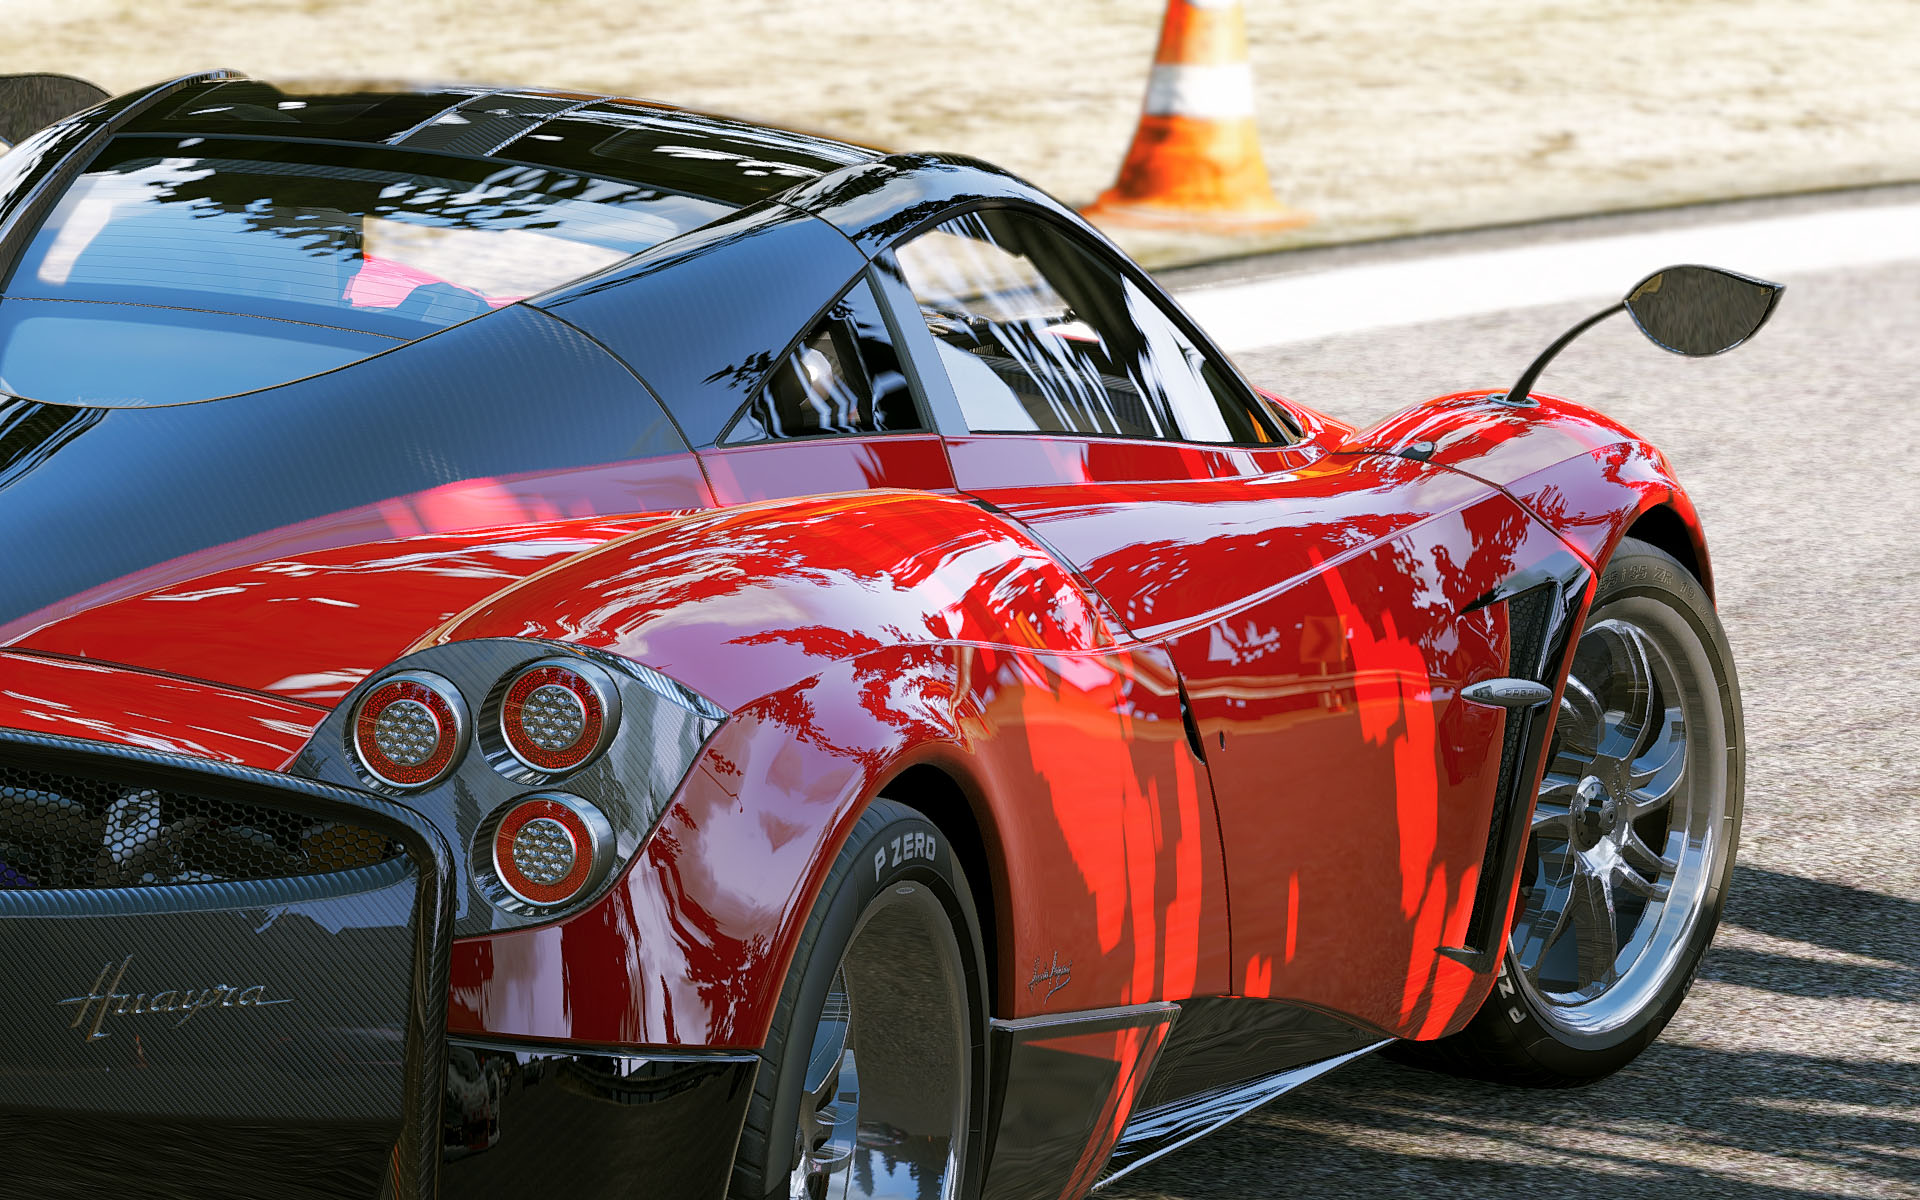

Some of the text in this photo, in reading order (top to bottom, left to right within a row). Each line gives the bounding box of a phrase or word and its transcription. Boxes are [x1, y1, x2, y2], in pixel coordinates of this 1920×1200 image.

[874, 832, 936, 883] P ZERO
[56, 953, 295, 1042] Huayra
